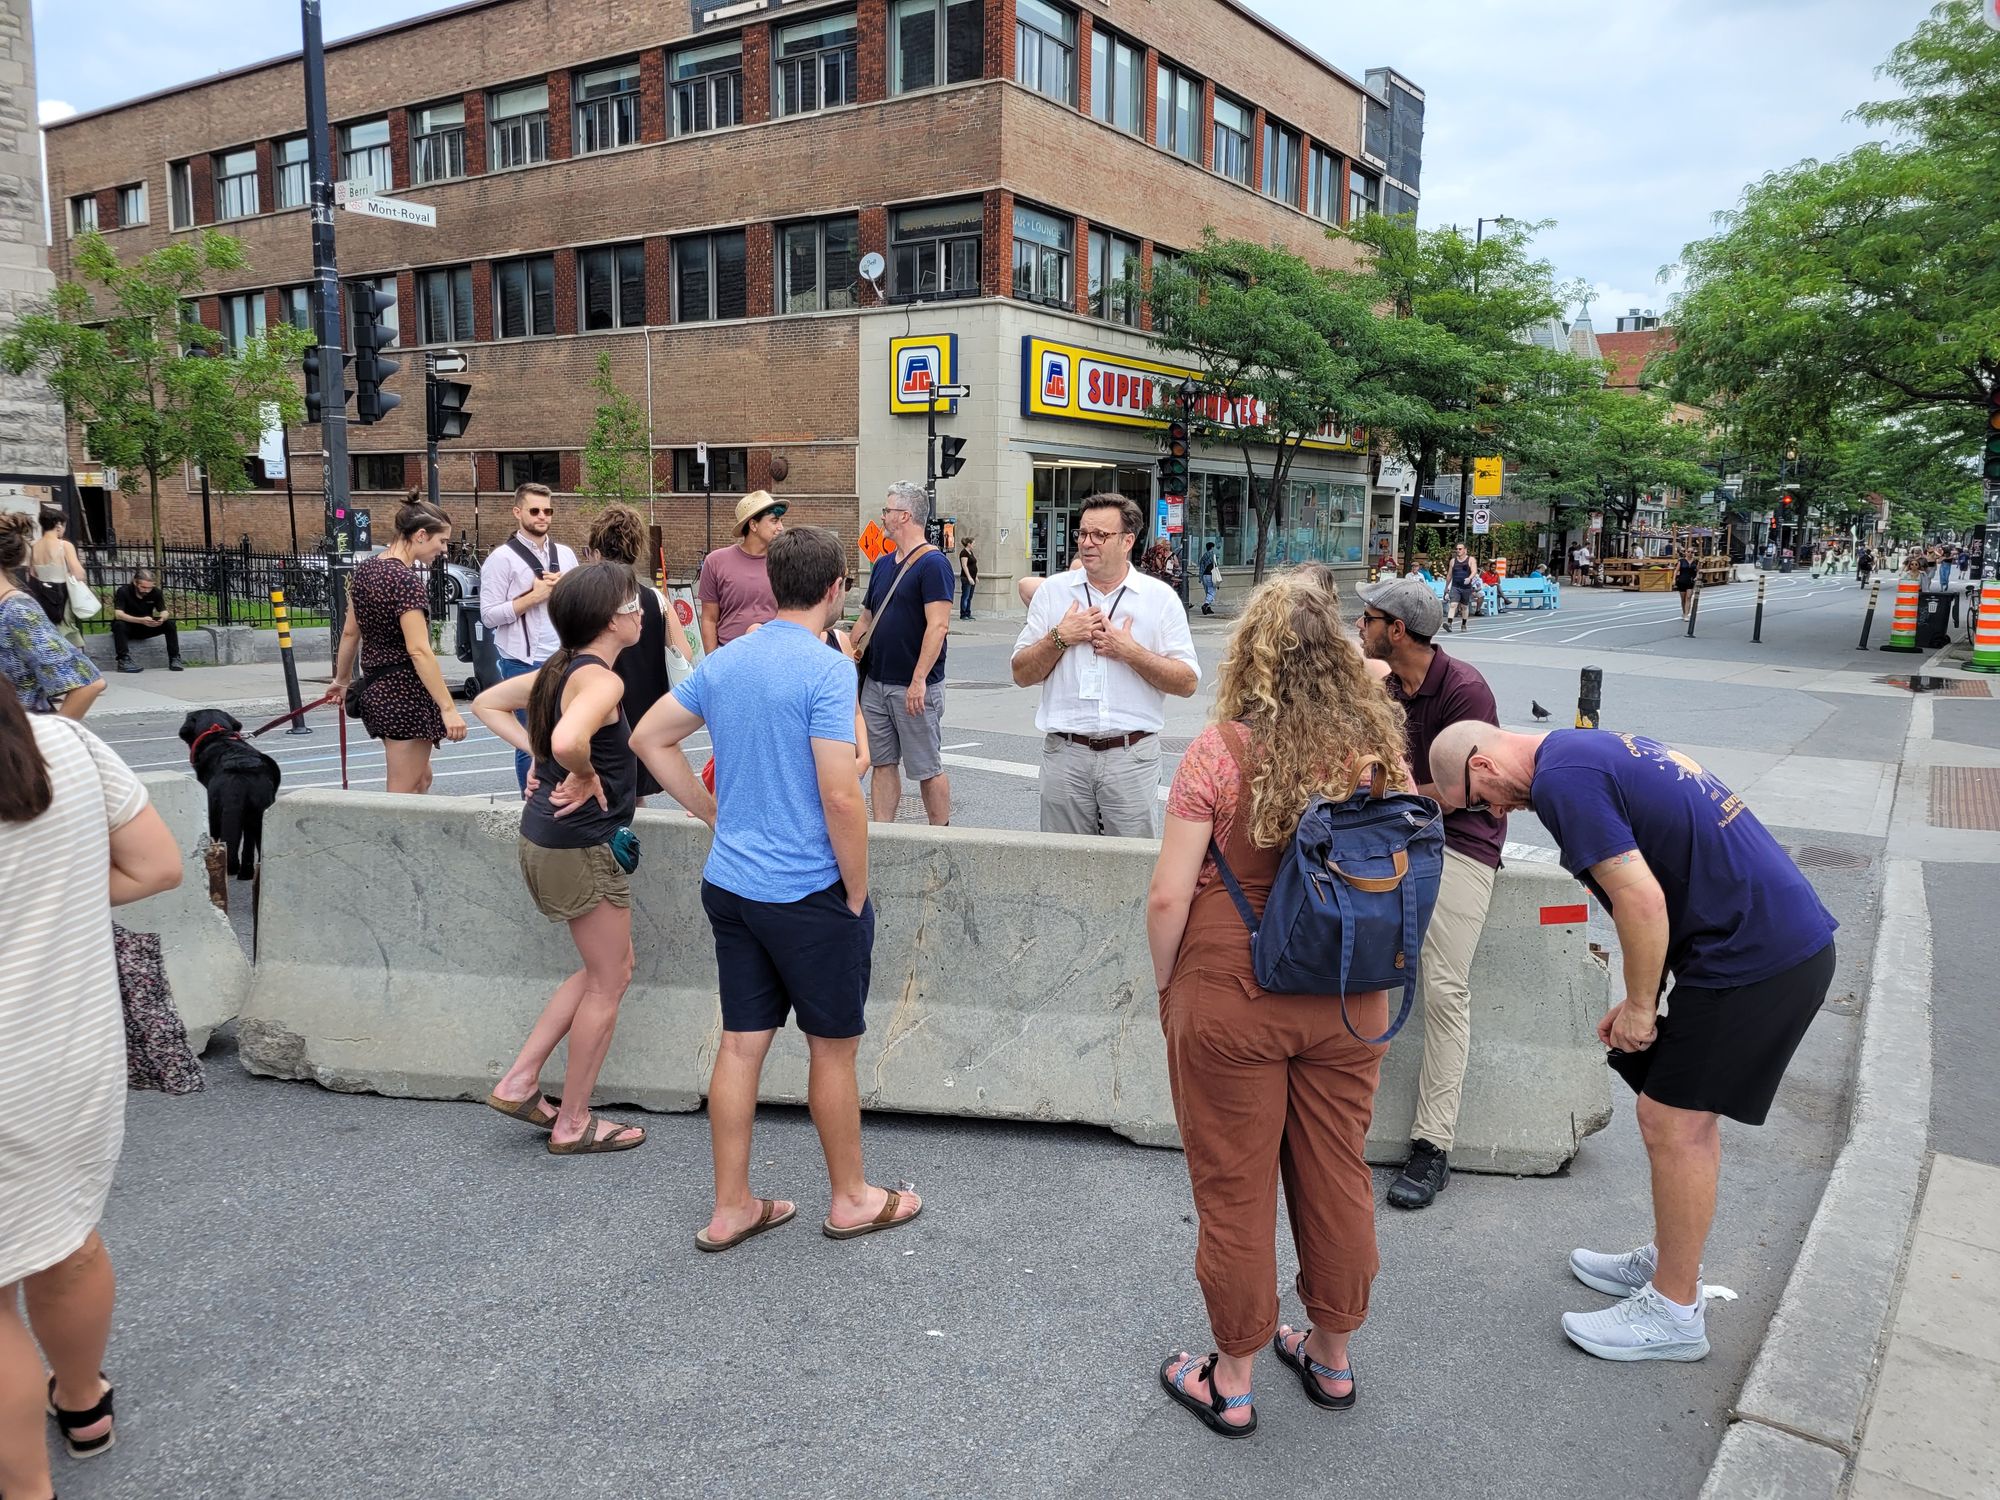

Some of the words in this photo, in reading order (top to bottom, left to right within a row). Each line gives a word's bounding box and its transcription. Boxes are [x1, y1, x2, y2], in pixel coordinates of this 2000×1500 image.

[349, 184, 369, 198] Berri
[368, 202, 430, 223] Mont-Royal
[1013, 215, 1026, 229] AR
[1031, 220, 1062, 239] LOUNGE
[1088, 368, 1153, 410] SUPER
